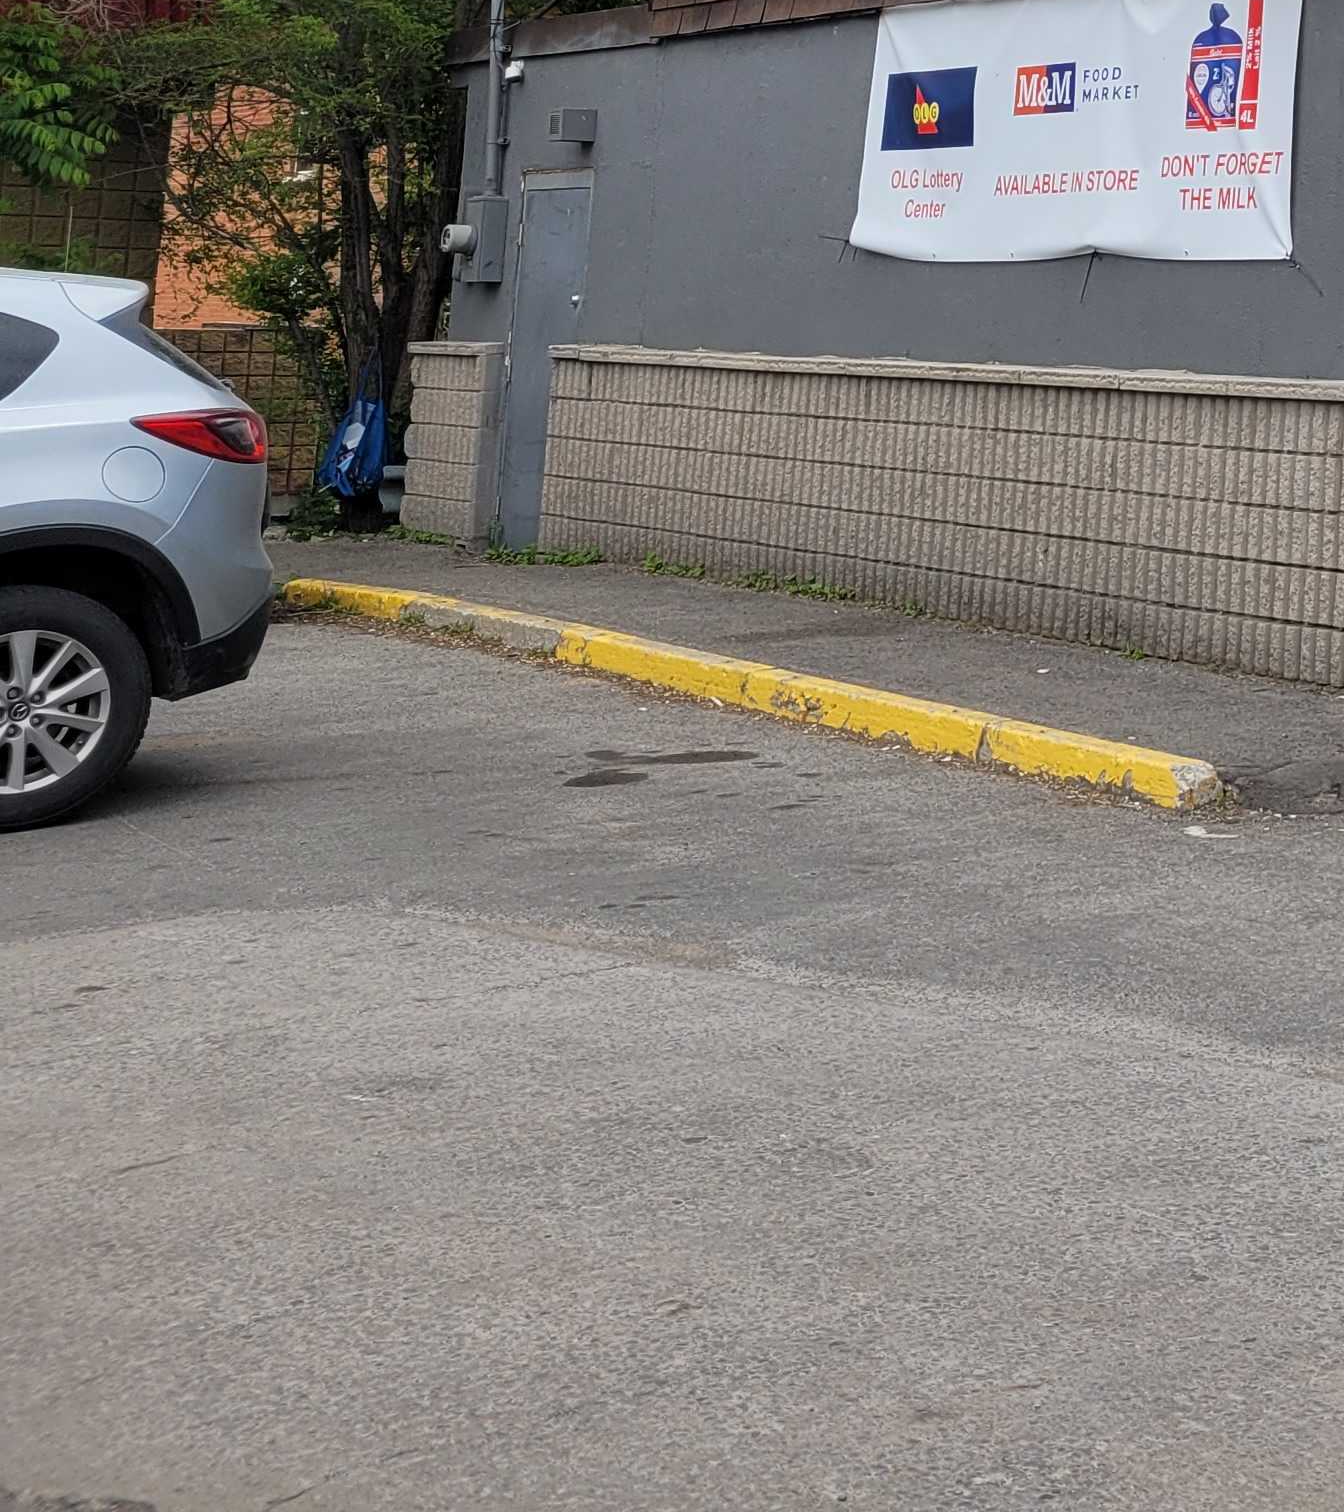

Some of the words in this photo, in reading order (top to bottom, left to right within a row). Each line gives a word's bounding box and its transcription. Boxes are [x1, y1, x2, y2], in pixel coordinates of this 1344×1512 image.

[1083, 66, 1122, 83] FOOD
[1017, 70, 1073, 108] M&M
[1082, 85, 1139, 103] MARKET
[1240, 109, 1254, 123] 4L
[1160, 154, 1211, 178] DON'T
[1215, 151, 1284, 176] FORGET
[891, 169, 919, 189] OLG
[922, 167, 963, 192] Lottery
[993, 172, 1069, 197] AVAILABLE
[1070, 171, 1084, 193] IN
[1086, 169, 1140, 192] STORE
[904, 199, 946, 218] Center
[1179, 187, 1213, 210] THE
[1217, 185, 1258, 210] MILK
